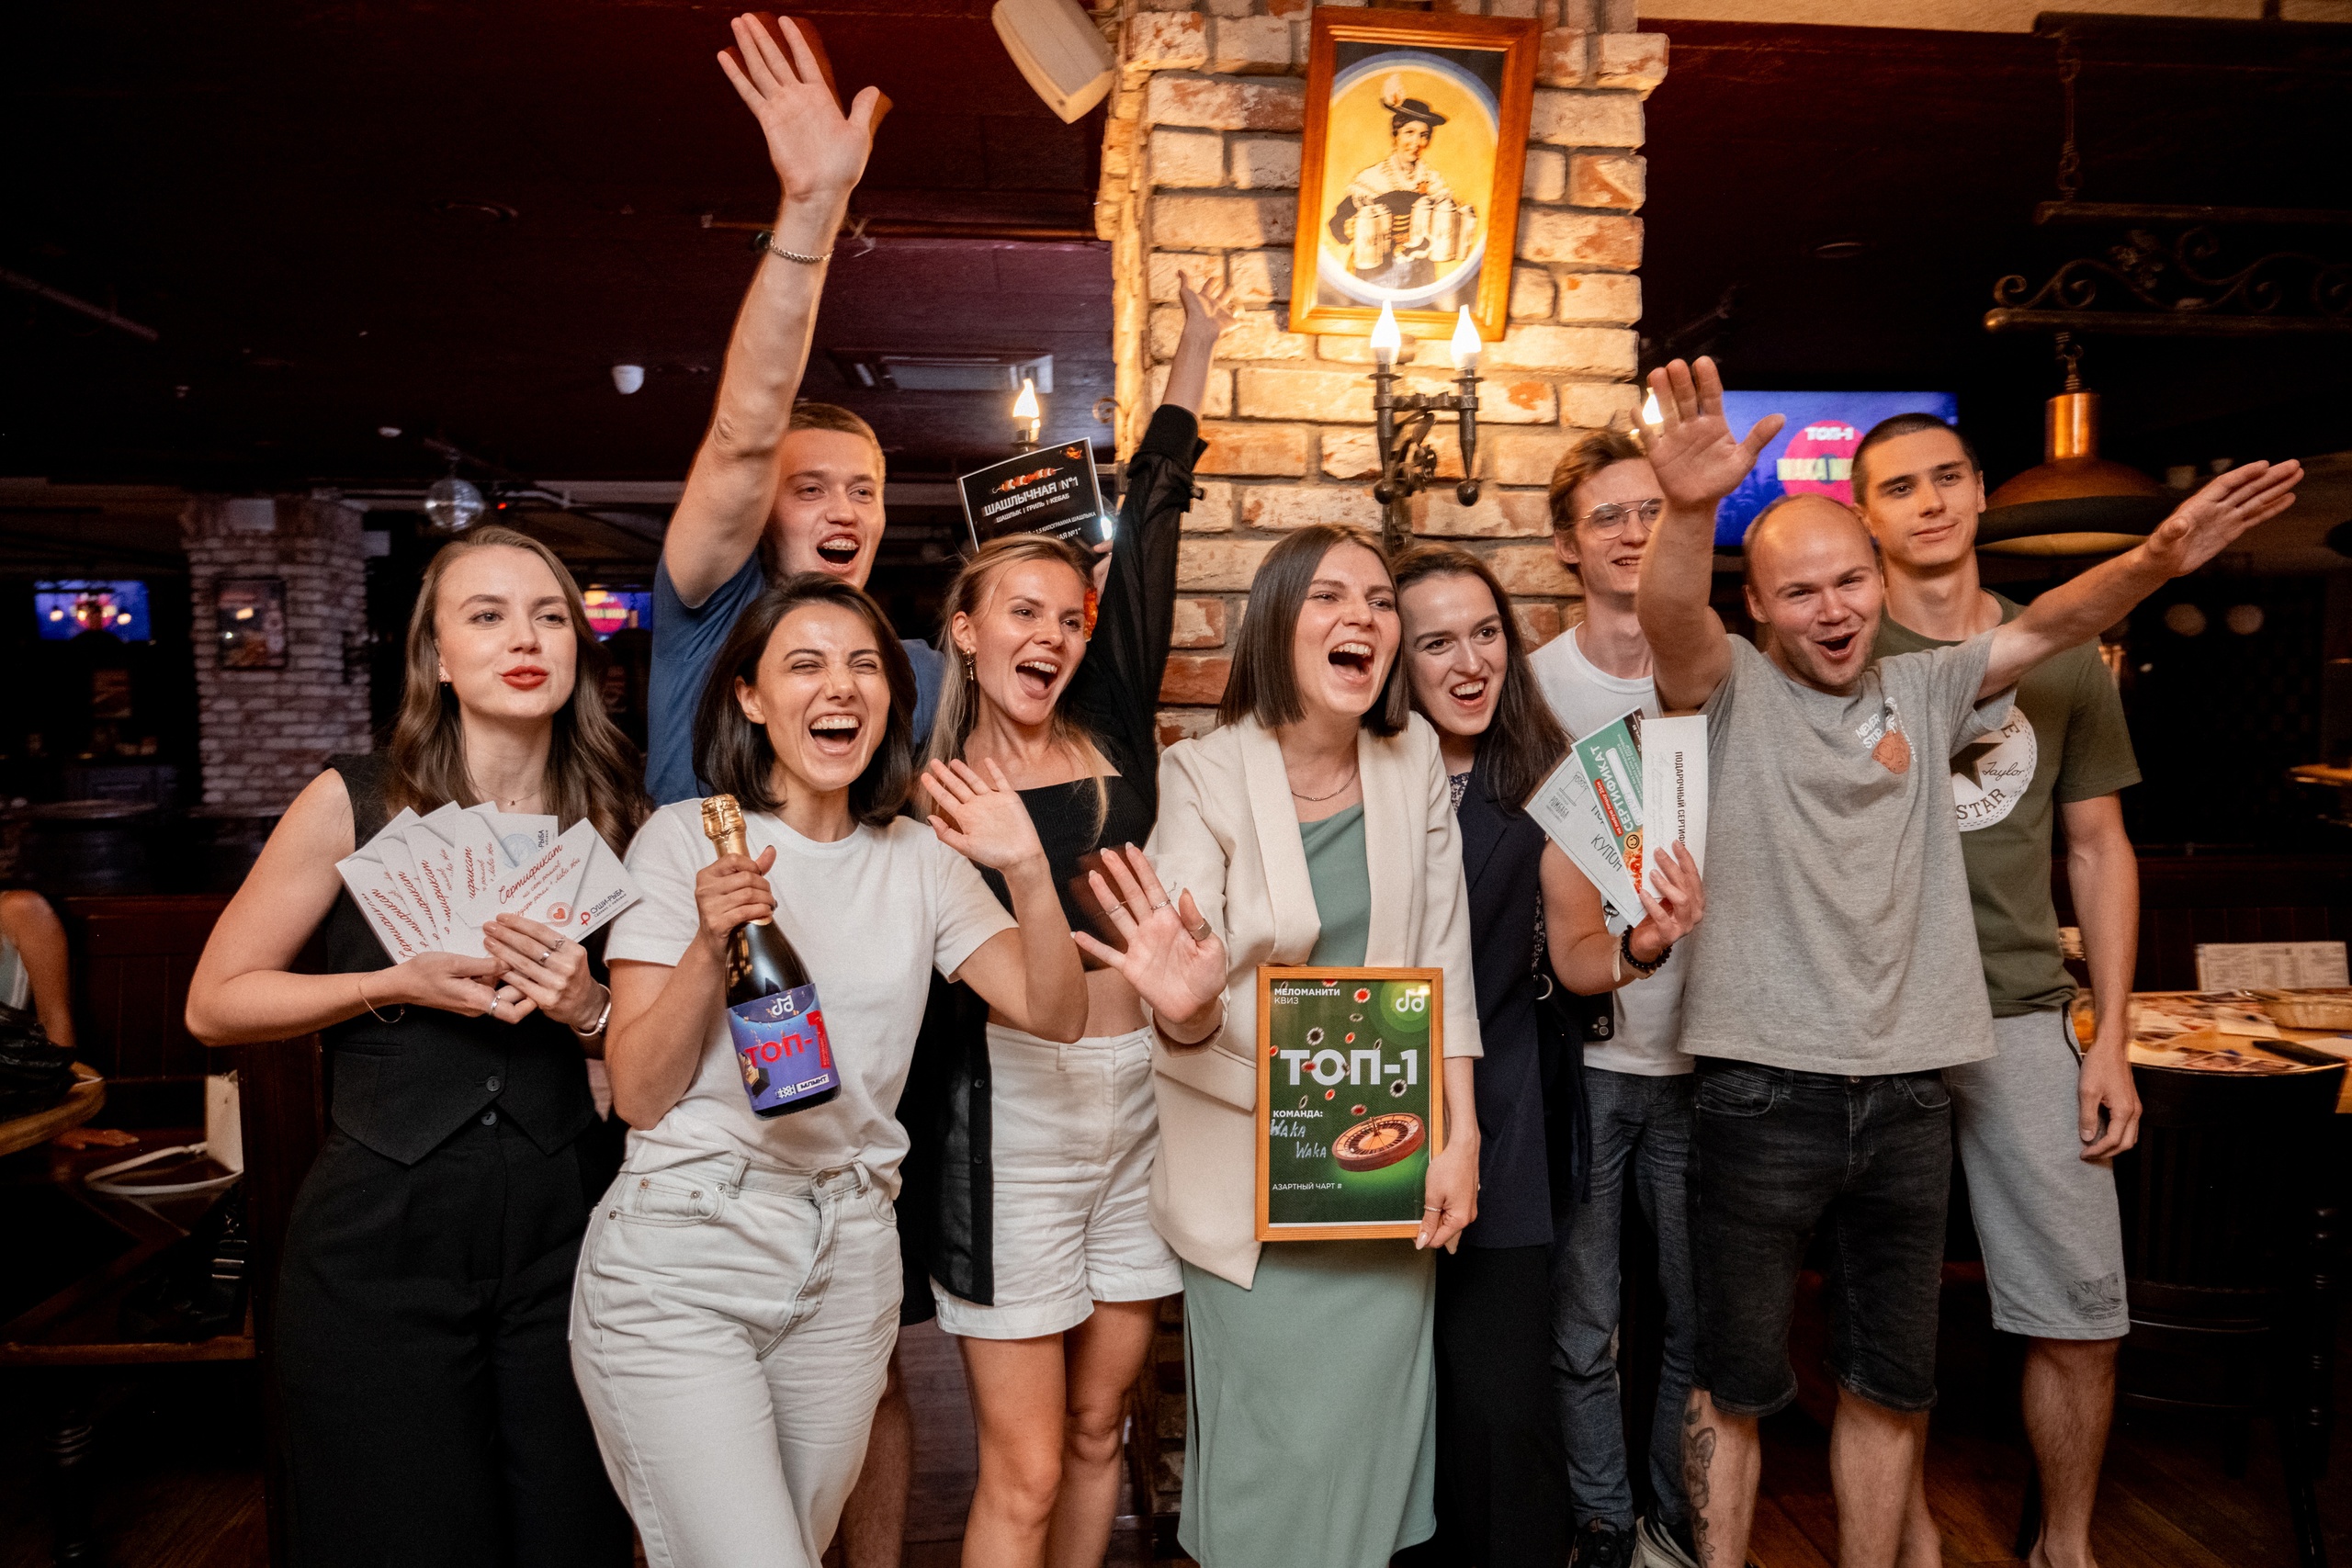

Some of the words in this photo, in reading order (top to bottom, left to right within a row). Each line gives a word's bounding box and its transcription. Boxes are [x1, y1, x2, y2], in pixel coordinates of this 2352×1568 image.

[983, 482, 1057, 516] ШАШЛЫЧНАЯ
[996, 510, 1022, 523] ШАШЛЫК
[1026, 502, 1045, 512] ГРИЛЬ
[1050, 493, 1069, 504] КЕБАБ
[1855, 713, 1883, 739] NEVER
[1862, 728, 1884, 750] STOP
[1675, 751, 1685, 808] ПОДАРОЧНЫЙ
[1982, 761, 2025, 781] Taylor
[1589, 744, 1634, 832] СЕРТИФИКАТ
[1956, 788, 2007, 819] STAR
[1678, 809, 1686, 847] СЕРТИФ
[1590, 833, 1623, 872] КУПОН
[464, 845, 480, 898] ификат
[498, 842, 564, 904] Сертификат
[588, 887, 625, 915] СУШИ-РЫБА
[1274, 987, 1340, 996] МЕЛОМАНИТИ
[1274, 997, 1299, 1005] КВИЗ
[744, 1010, 831, 1069] ТОП-1
[1280, 1048, 1418, 1086] ТОП-1
[1272, 1110, 1323, 1119] КОМАНДА:
[1272, 1181, 1315, 1190] АЗАРТНЫЙ
[1316, 1181, 1336, 1190] ЧАРТ
